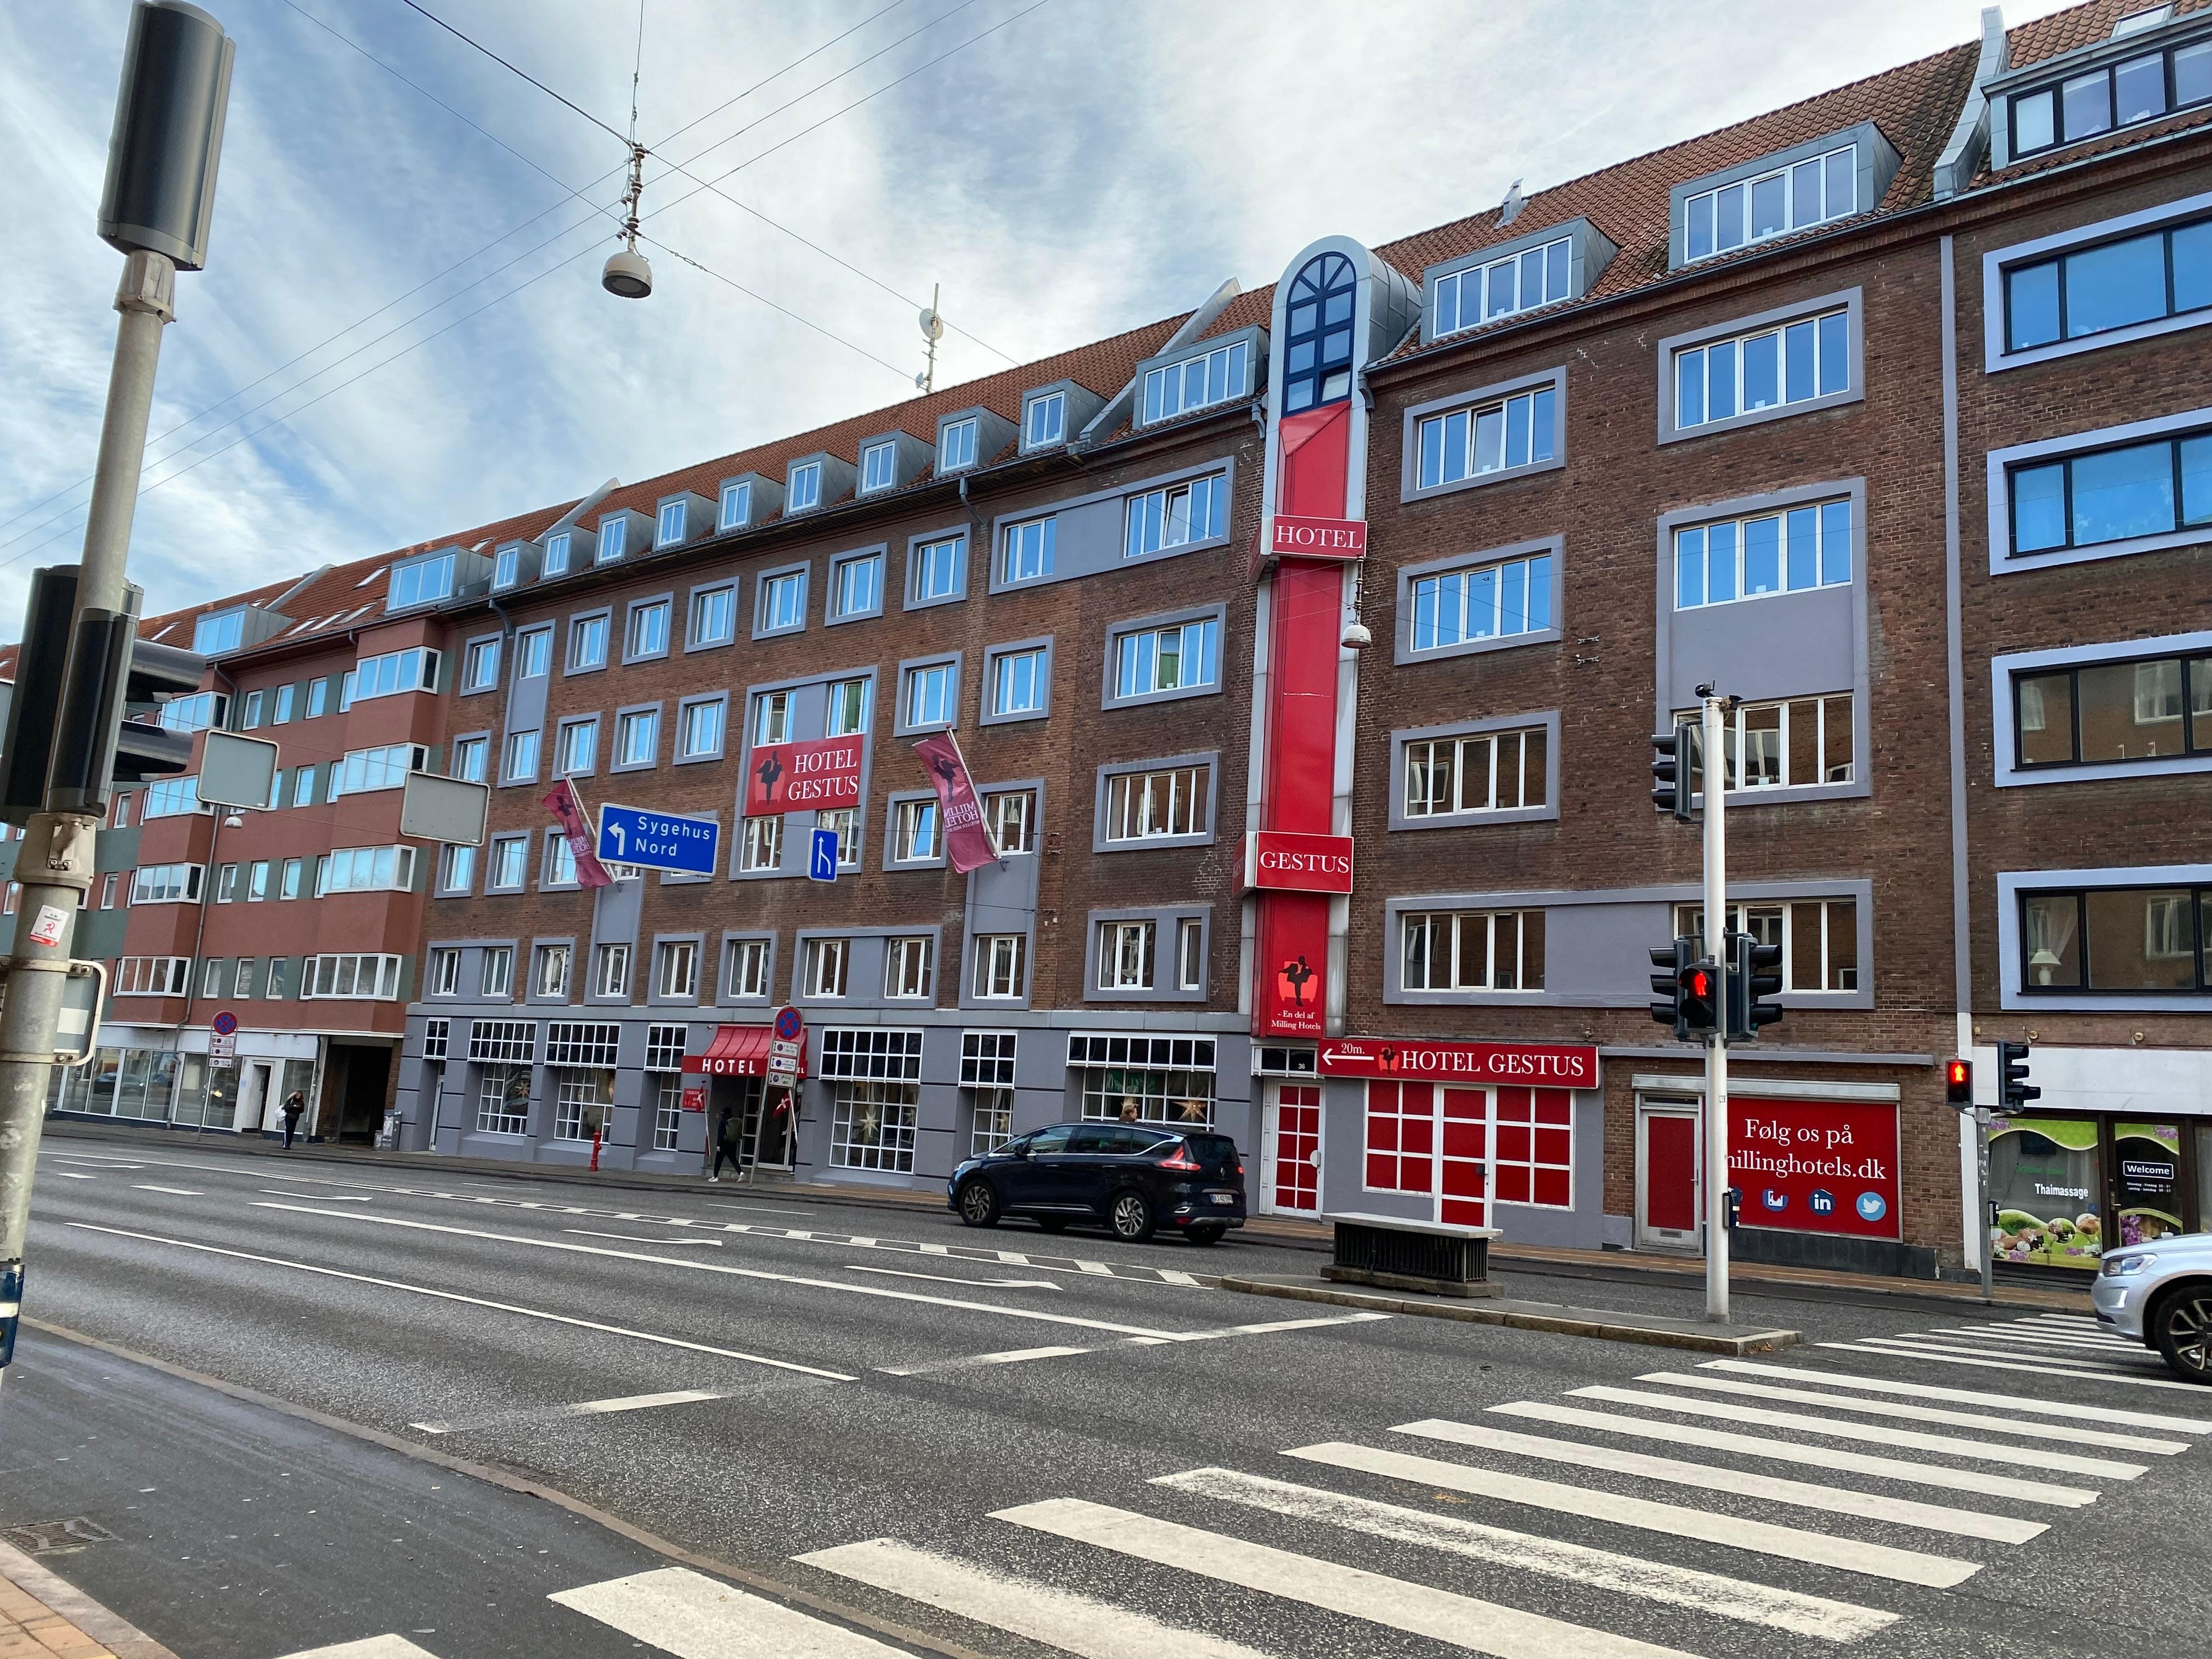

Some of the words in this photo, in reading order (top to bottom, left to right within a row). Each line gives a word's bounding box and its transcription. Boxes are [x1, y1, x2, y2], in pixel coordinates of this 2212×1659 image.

[1276, 525, 1362, 549] HOTEL
[793, 749, 856, 774] HOTEL
[788, 775, 858, 800] GESTUS
[637, 816, 710, 840] Sygehus
[635, 838, 677, 856] Nord
[1260, 851, 1349, 873] GESTUS
[1283, 1010, 1293, 1018] En
[1271, 1020, 1296, 1030] Milling
[1298, 1022, 1321, 1030] Hotels
[1341, 1043, 1365, 1054] 20m.
[702, 1058, 755, 1074] HOTEL
[1401, 1051, 1480, 1072] HOTEL
[1488, 1053, 1584, 1076] GESTUS
[1745, 1119, 1791, 1146] Følg
[1797, 1128, 1819, 1142] os
[1826, 1124, 1854, 1149] på
[2127, 1165, 2170, 1175] Welcome
[2035, 1183, 2089, 1200] Thaimassage
